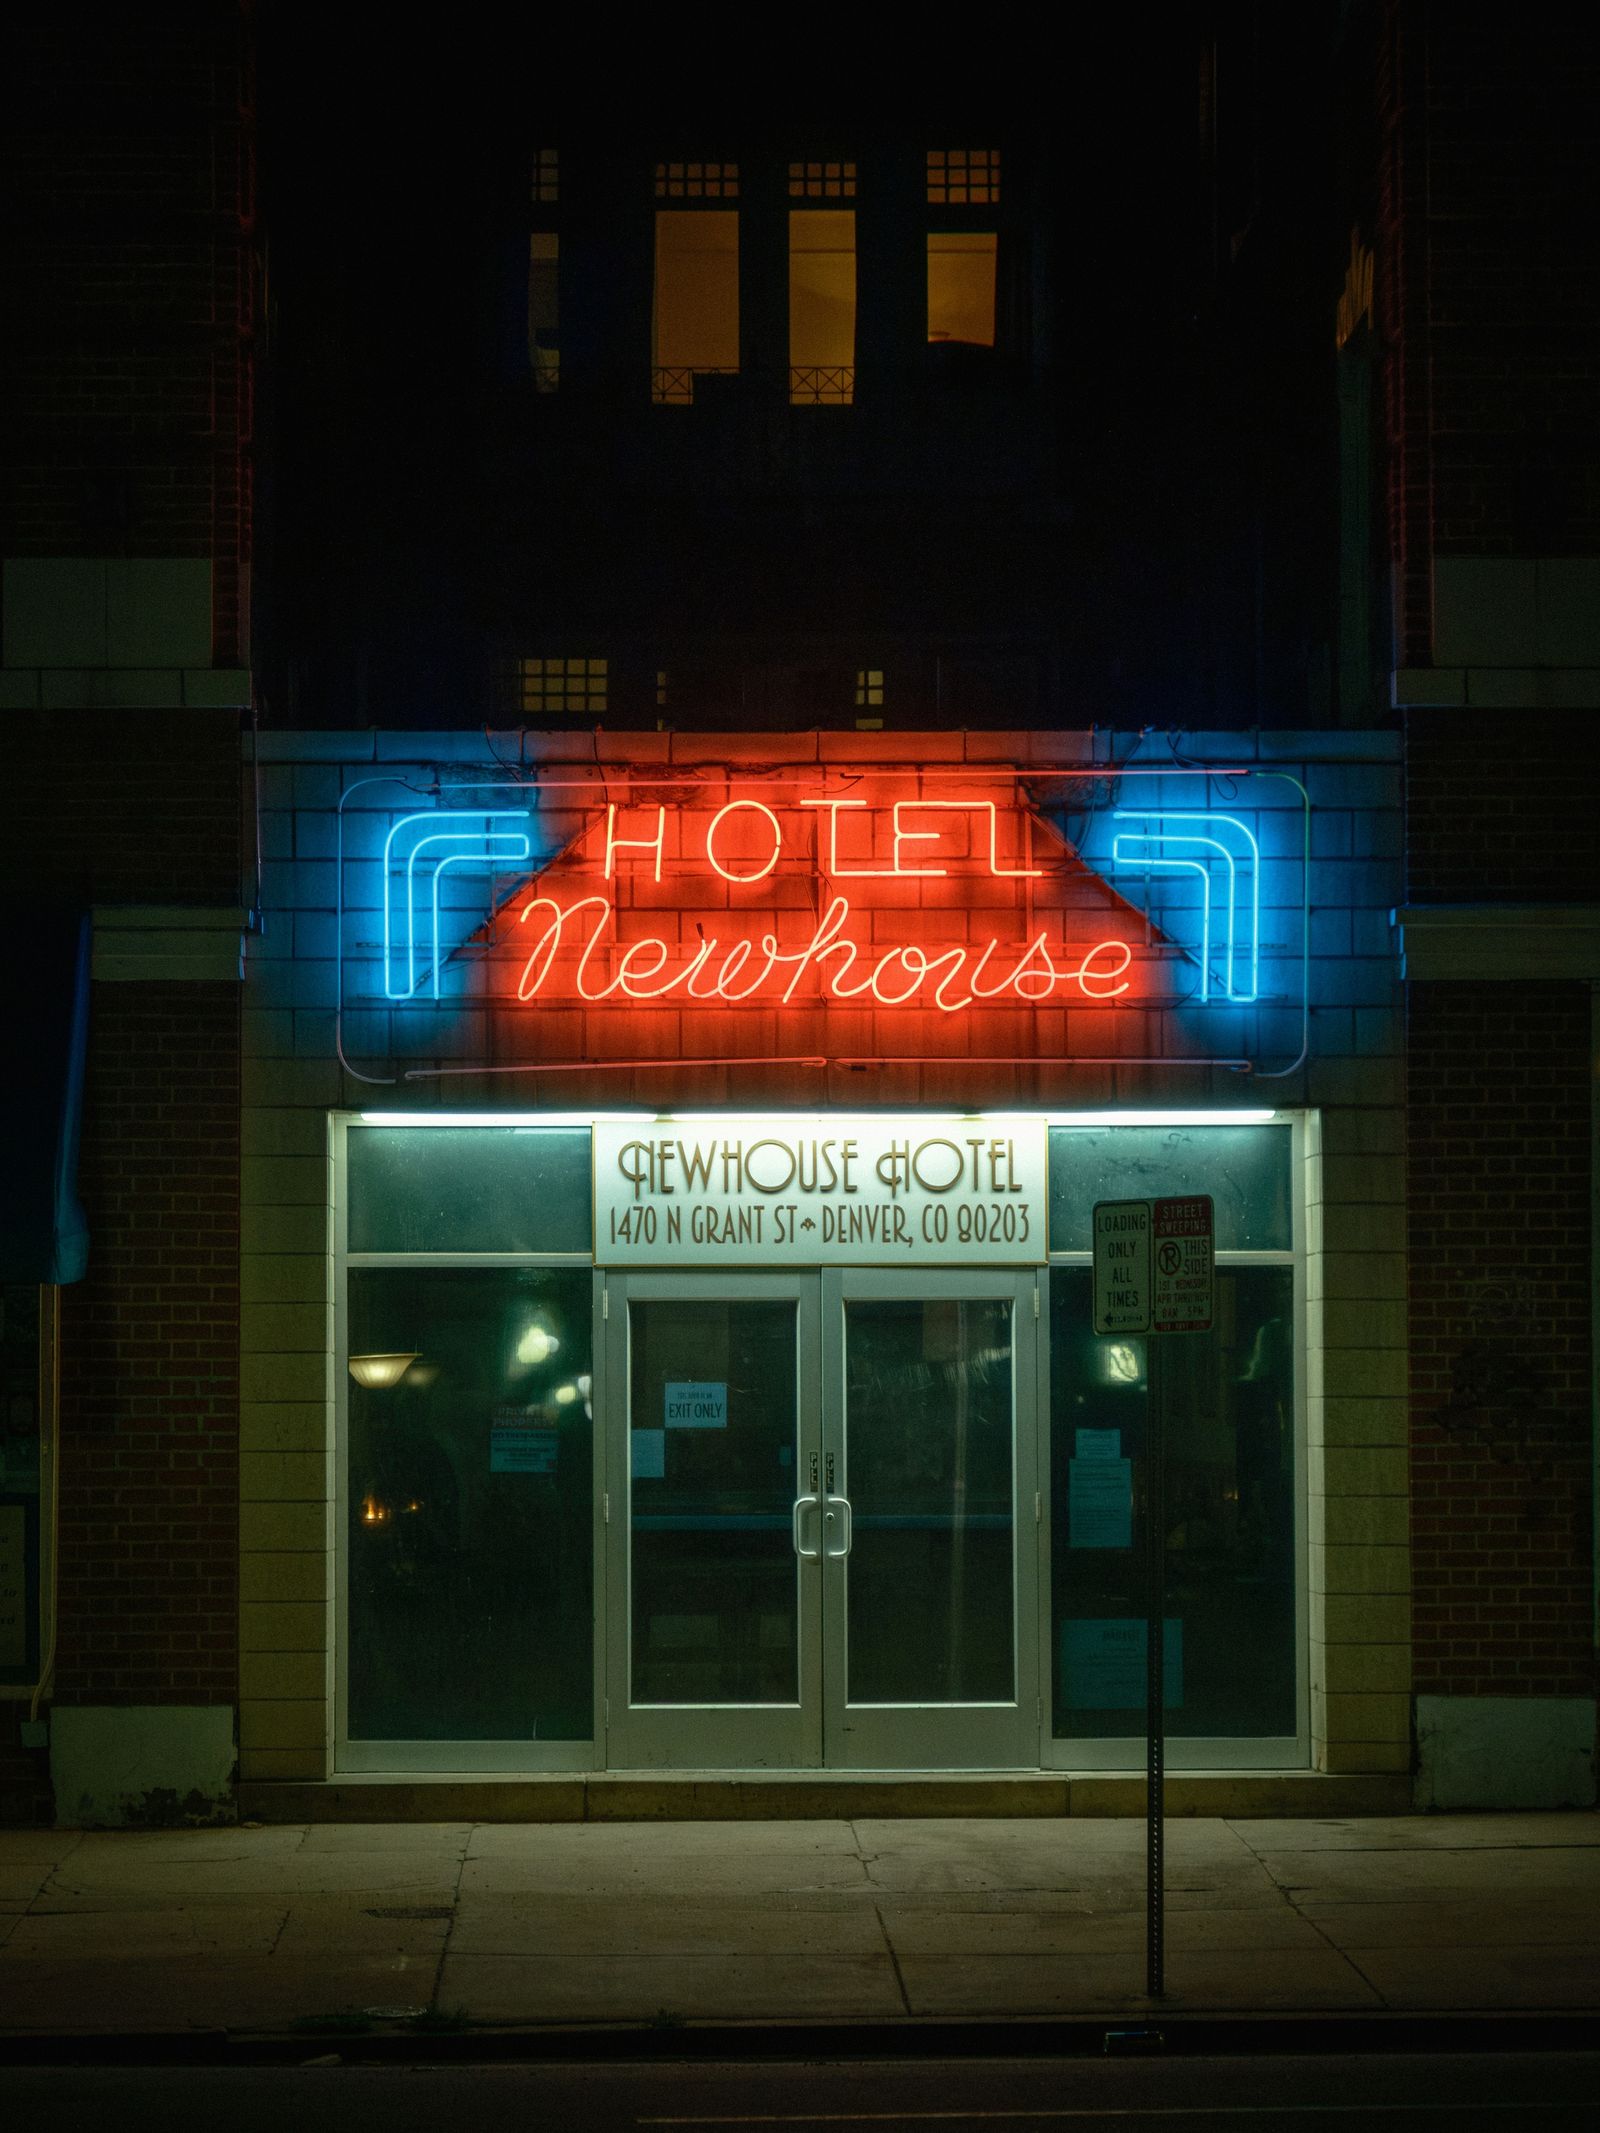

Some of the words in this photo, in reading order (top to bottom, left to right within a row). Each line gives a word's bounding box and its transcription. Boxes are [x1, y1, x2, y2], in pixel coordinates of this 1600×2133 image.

[604, 799, 1043, 882] HOTEL
[516, 896, 1132, 1012] Newhouse
[617, 1138, 859, 1200] NEWHOUSE
[875, 1137, 1023, 1199] HOTEL
[1162, 1204, 1203, 1219] STREET
[610, 1205, 658, 1245] 1470
[667, 1205, 682, 1245] N
[691, 1205, 765, 1245] GRANT
[773, 1205, 798, 1245] ST
[822, 1205, 913, 1248] DENVER,
[922, 1204, 948, 1244] CO
[957, 1204, 1030, 1244] 80203
[1098, 1214, 1146, 1233] LOADING
[1159, 1219, 1207, 1234] SWEEPING
[1108, 1241, 1136, 1259] ONLY
[1183, 1239, 1207, 1256] THIS
[1112, 1267, 1133, 1284] ALL
[1183, 1258, 1208, 1275] SIDE
[1106, 1290, 1139, 1308] TIMES
[668, 1403, 691, 1418] EXIT
[694, 1403, 722, 1418] ONLY
